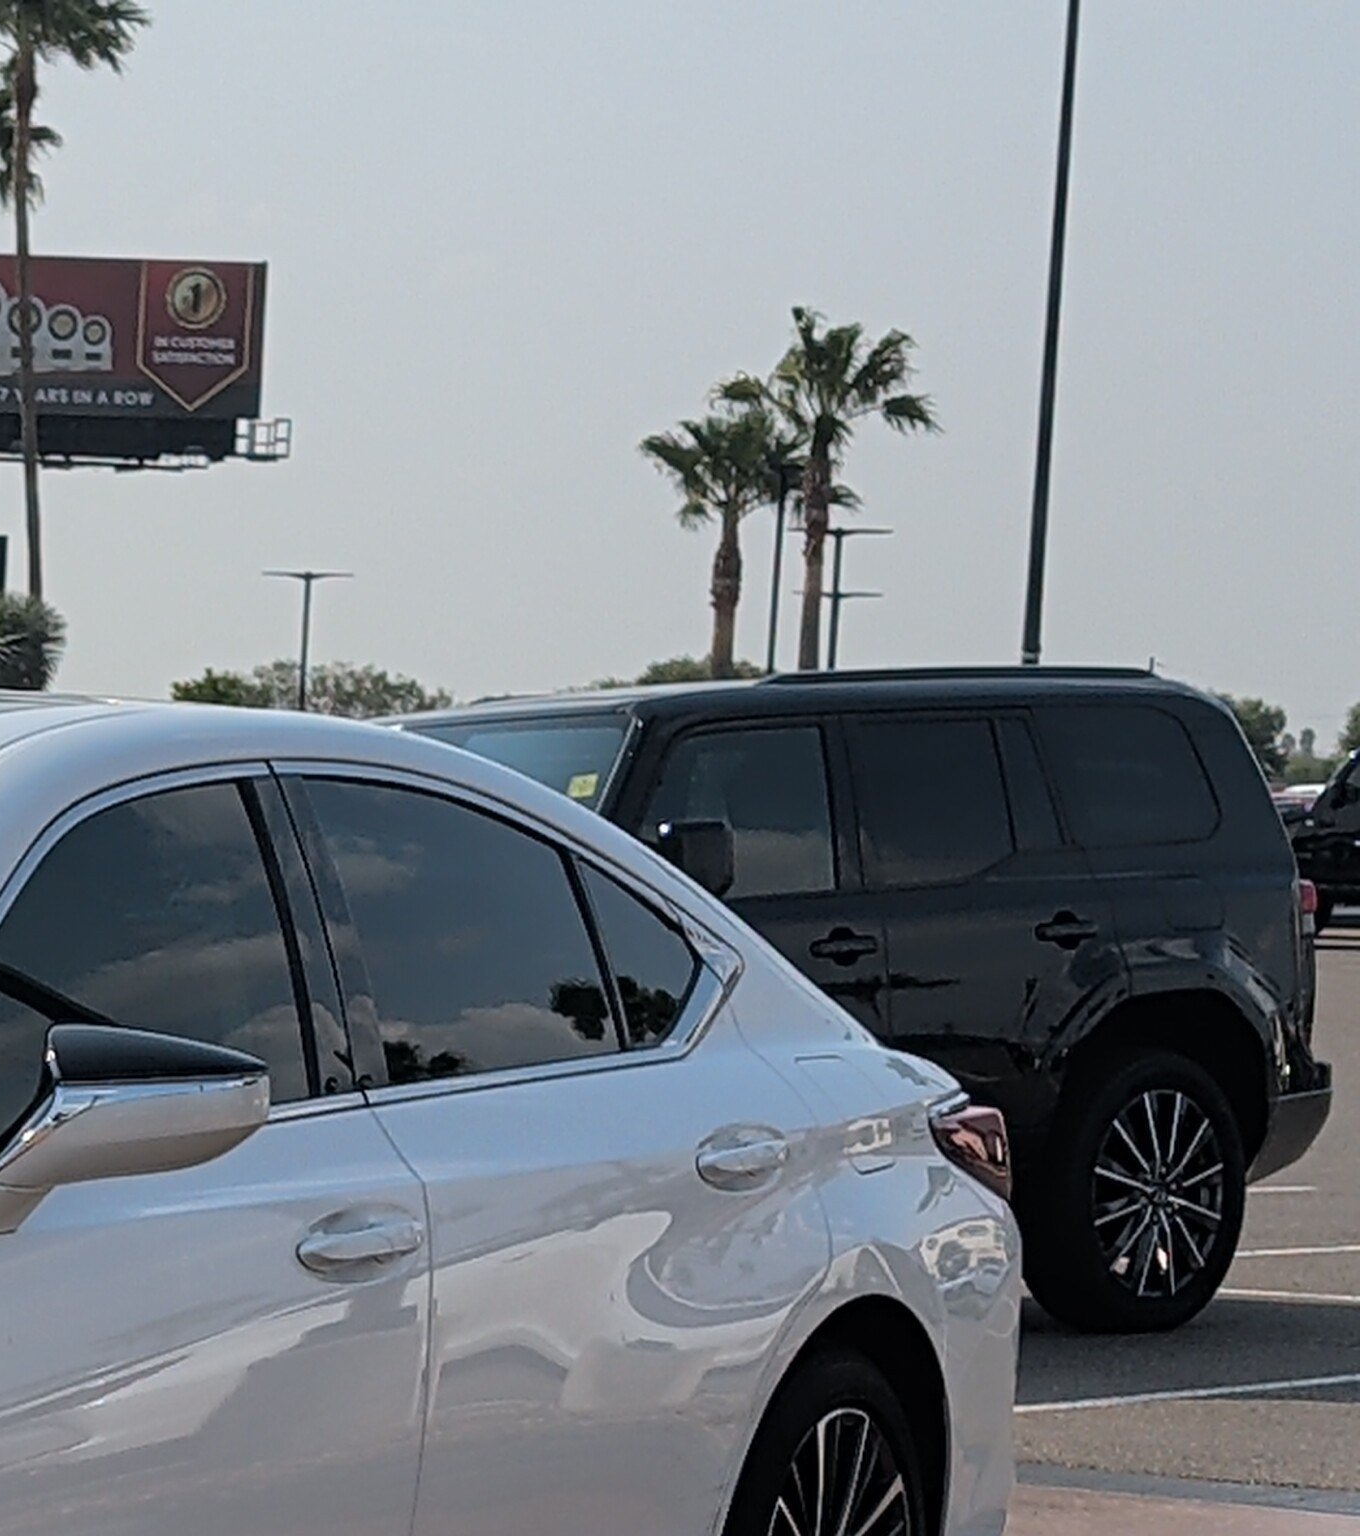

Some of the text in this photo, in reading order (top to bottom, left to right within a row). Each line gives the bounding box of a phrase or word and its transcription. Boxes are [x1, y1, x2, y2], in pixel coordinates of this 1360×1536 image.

[170, 336, 235, 350] CUSTOMER
[96, 390, 111, 405] A
[113, 390, 154, 406] ROW
